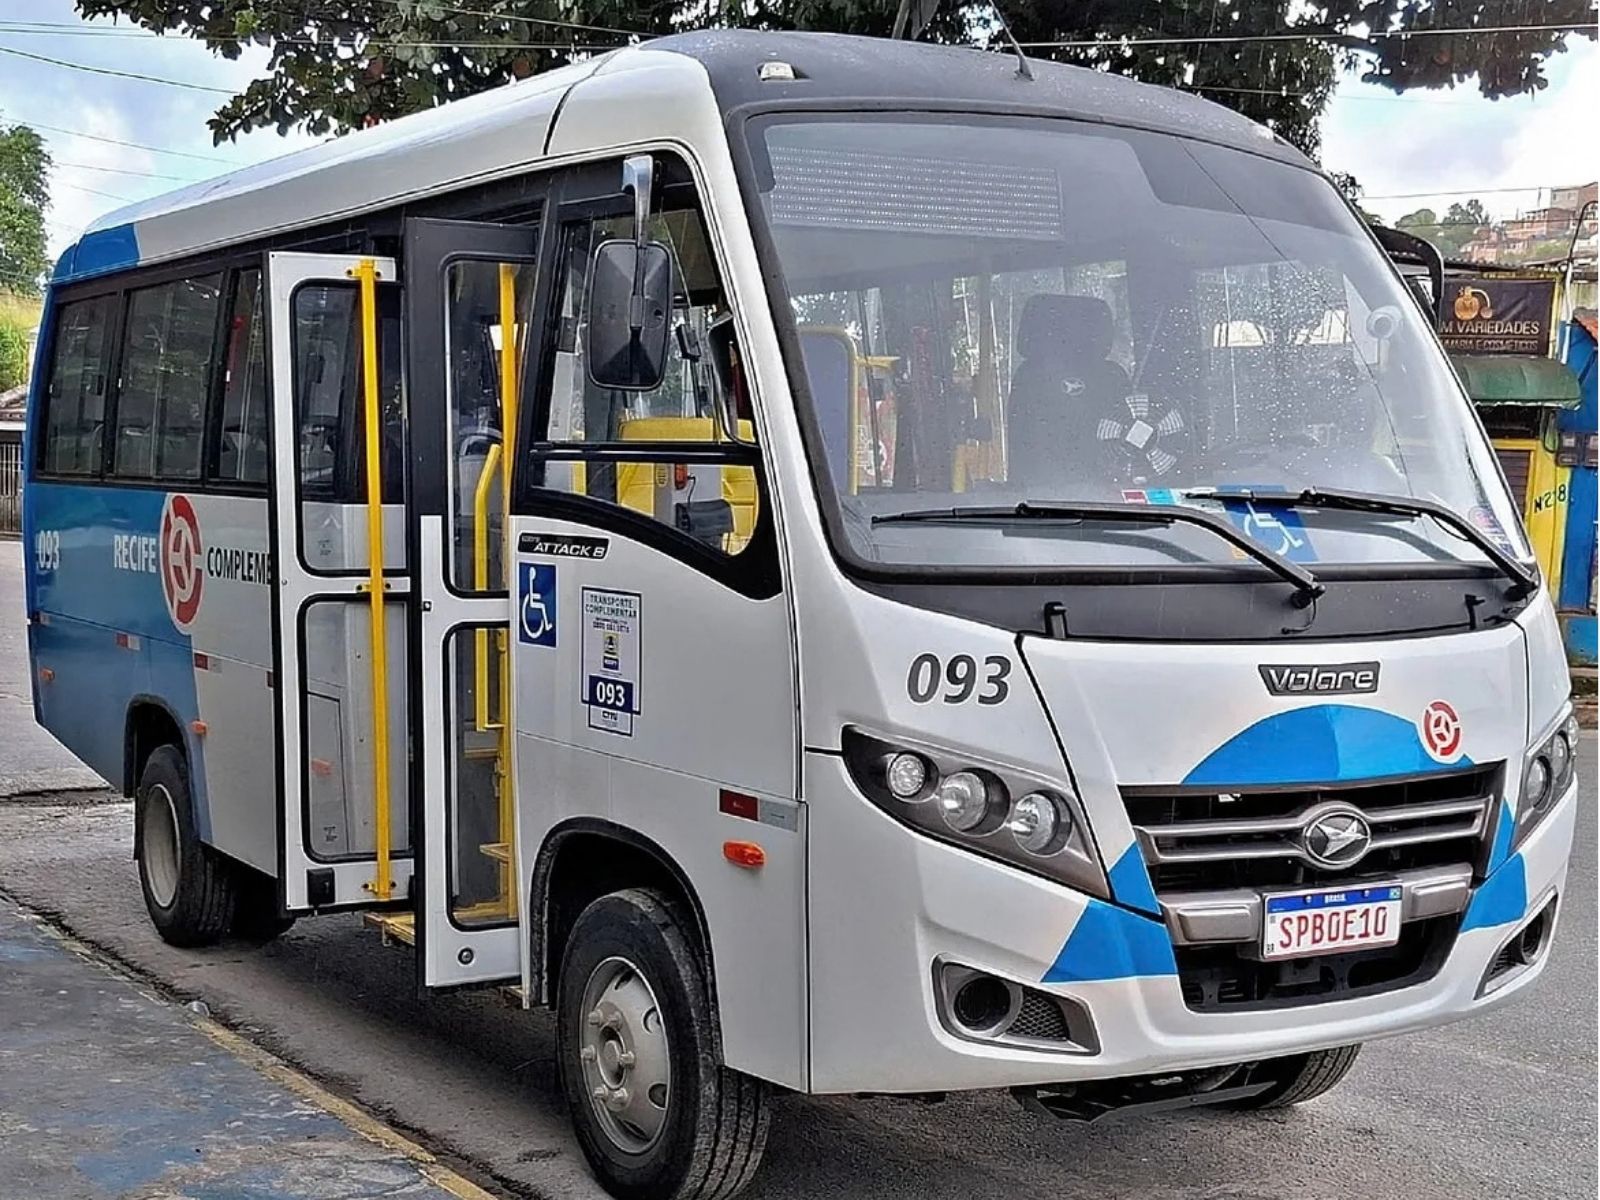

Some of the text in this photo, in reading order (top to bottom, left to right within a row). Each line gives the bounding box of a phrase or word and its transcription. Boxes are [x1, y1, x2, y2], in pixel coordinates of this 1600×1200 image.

[1457, 320, 1540, 335] VARIEDADES
[38, 530, 60, 570] 093
[113, 534, 157, 573] RECIFE
[533, 541, 605, 557] ATTACK 8
[585, 603, 637, 618] COMPLEMENTAR
[590, 594, 633, 608] TRANSPORTE
[907, 652, 1012, 705] 093
[1268, 666, 1374, 692] Volare
[596, 681, 625, 707] 093
